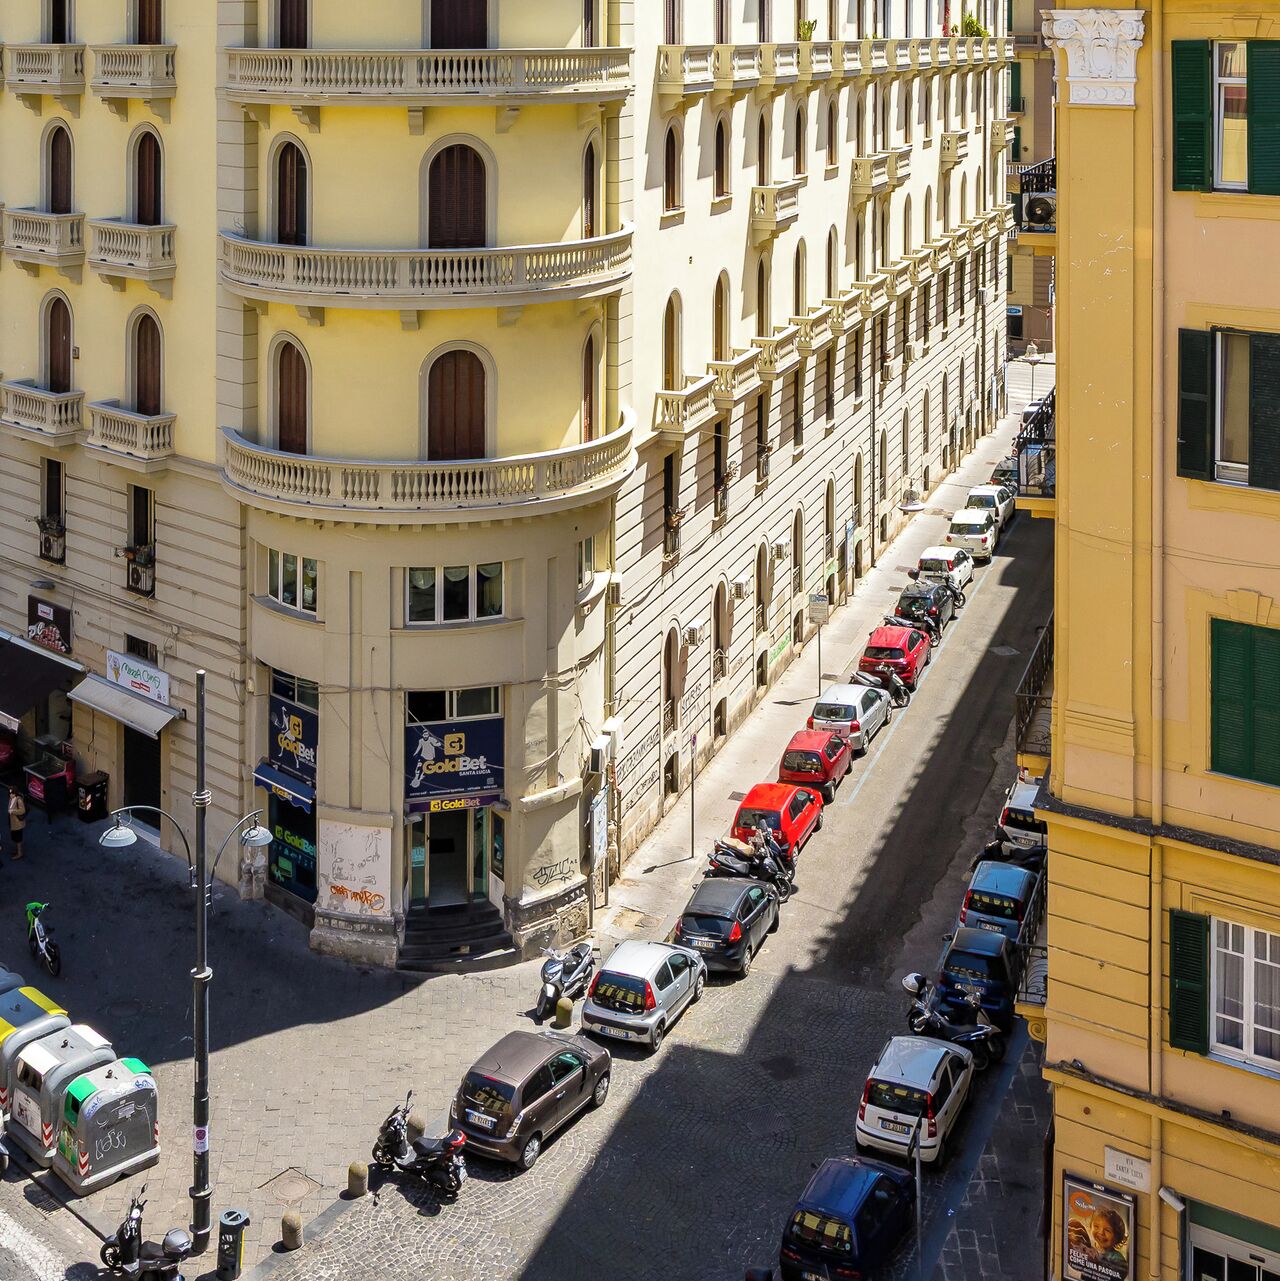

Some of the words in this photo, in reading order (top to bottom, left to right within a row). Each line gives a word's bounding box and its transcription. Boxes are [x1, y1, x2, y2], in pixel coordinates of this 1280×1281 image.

[278, 733, 315, 763] GoldBet
[422, 755, 487, 775] GoldBet
[442, 798, 481, 810] GoldBet
[1069, 1248, 1089, 1261] FELICE
[1069, 1255, 1085, 1267] COME
[1085, 1261, 1098, 1271] UNA
